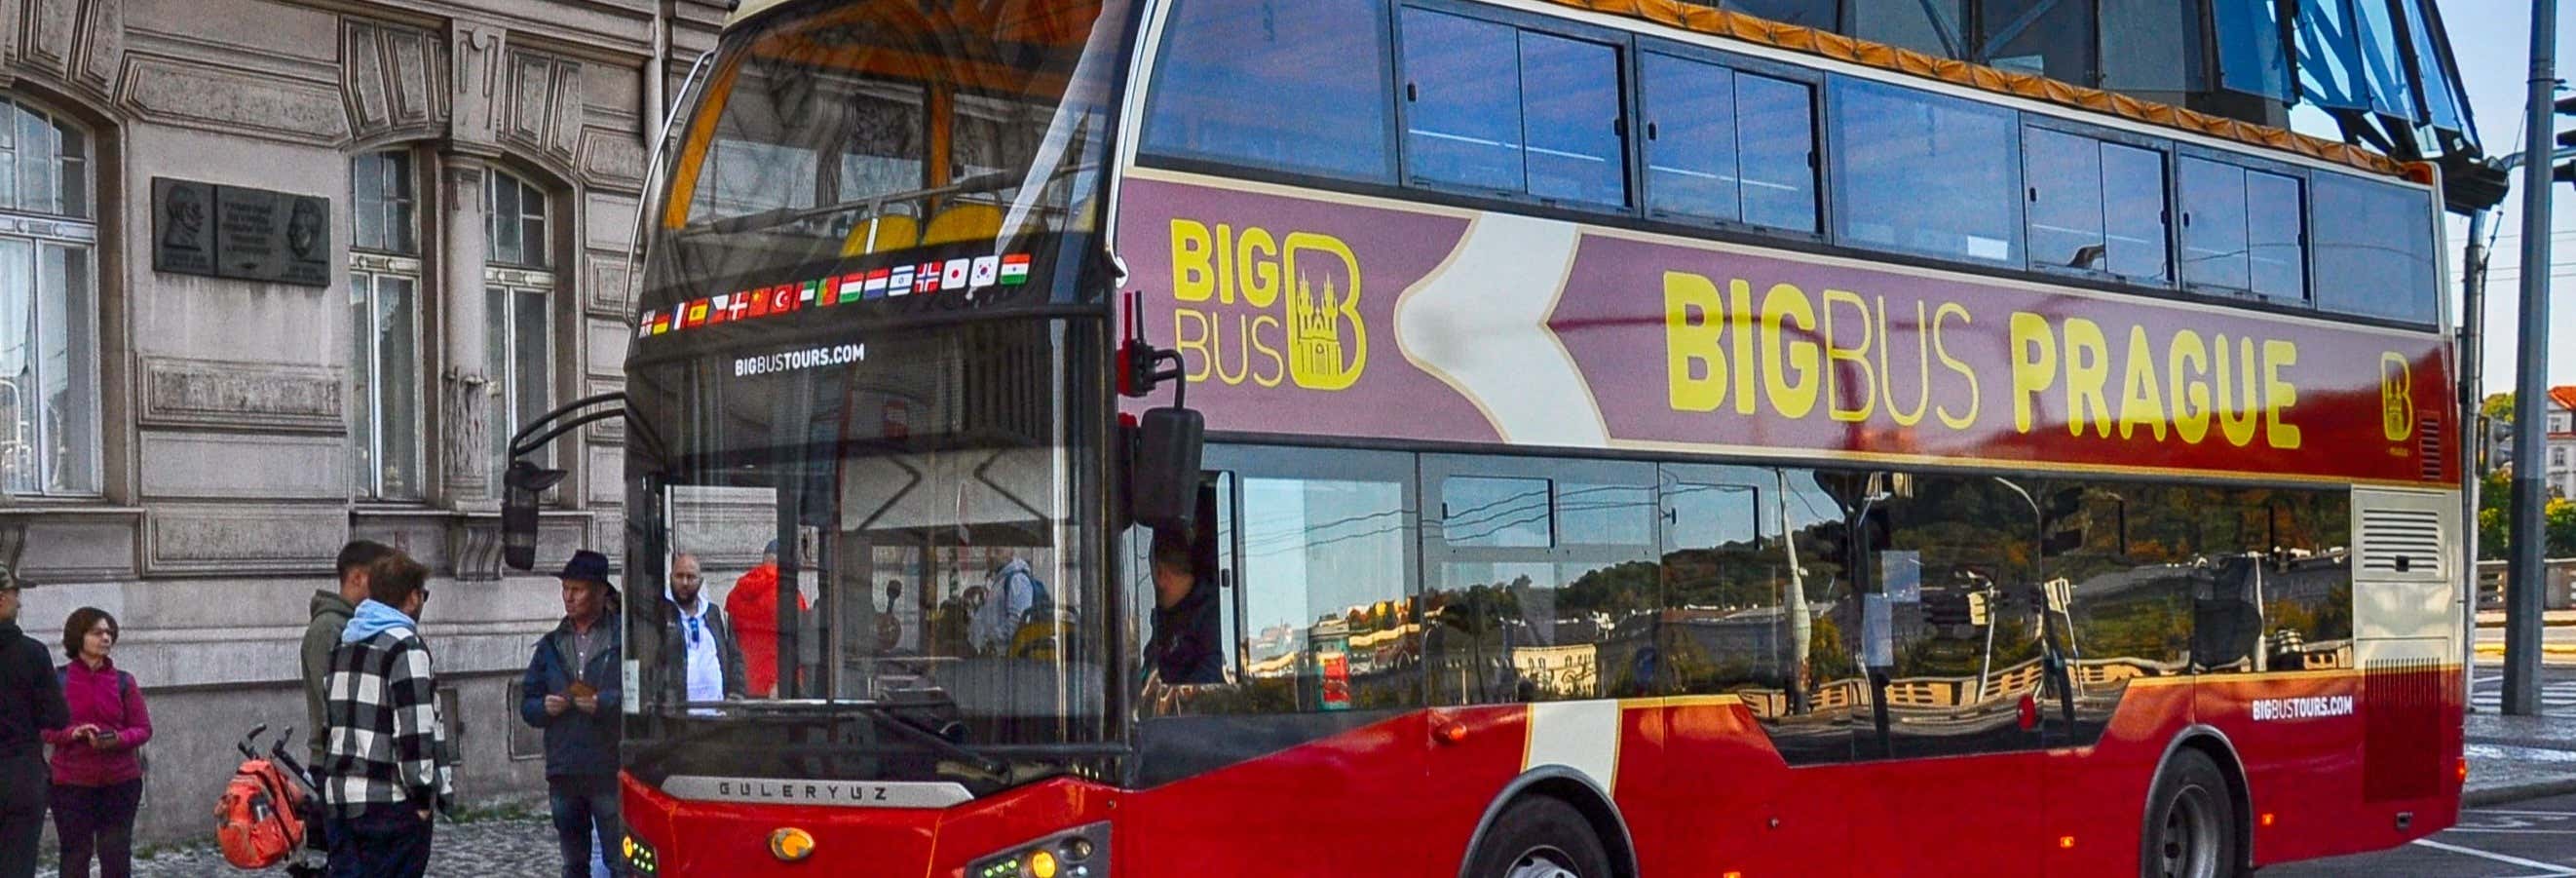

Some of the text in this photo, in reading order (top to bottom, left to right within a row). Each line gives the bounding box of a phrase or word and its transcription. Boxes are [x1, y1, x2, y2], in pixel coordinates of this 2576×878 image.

[1170, 218, 1279, 307] BIG
[735, 343, 865, 377] BIGBUSTOURS.COM
[1175, 308, 1284, 387] BUS
[2011, 311, 2301, 449] PRAGUE
[2253, 695, 2354, 721] BIGBUSTOURS.COM
